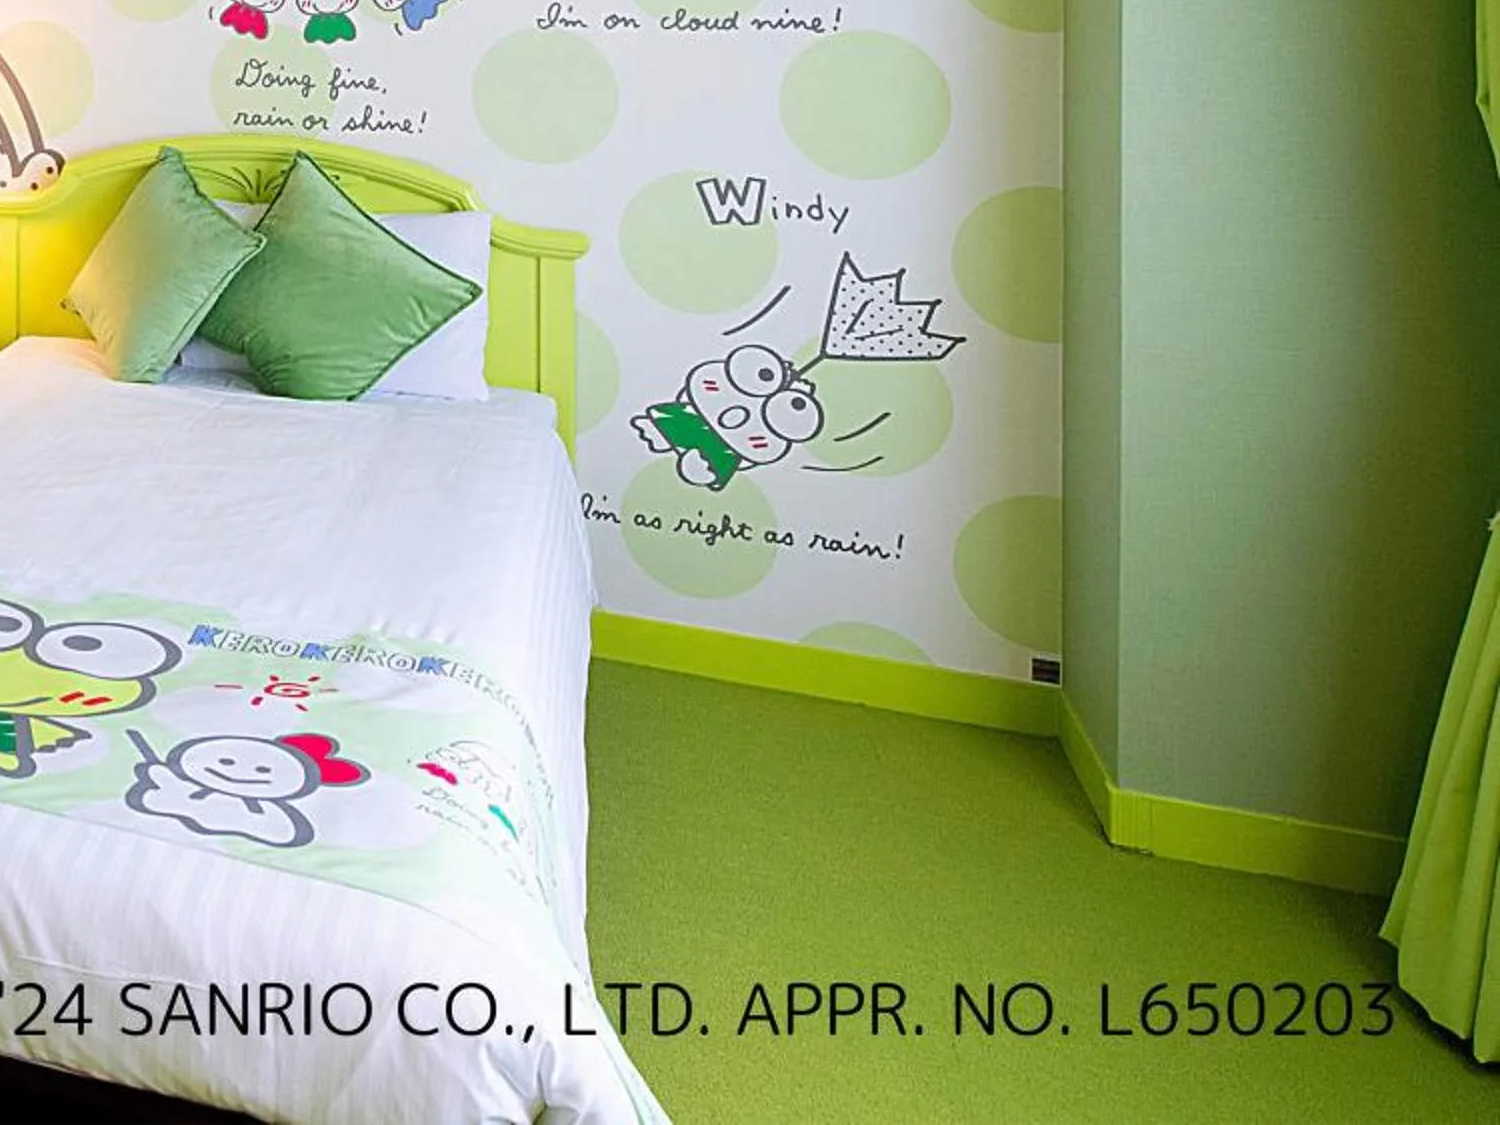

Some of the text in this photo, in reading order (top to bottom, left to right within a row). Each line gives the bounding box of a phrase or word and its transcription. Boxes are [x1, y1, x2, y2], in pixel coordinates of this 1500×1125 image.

[535, 1, 842, 34] I'm on cloud nine!
[234, 58, 317, 98] Doing
[232, 104, 427, 135] rain or shine!
[695, 176, 850, 235] Windy
[579, 492, 905, 560] I'm as right as rain!
